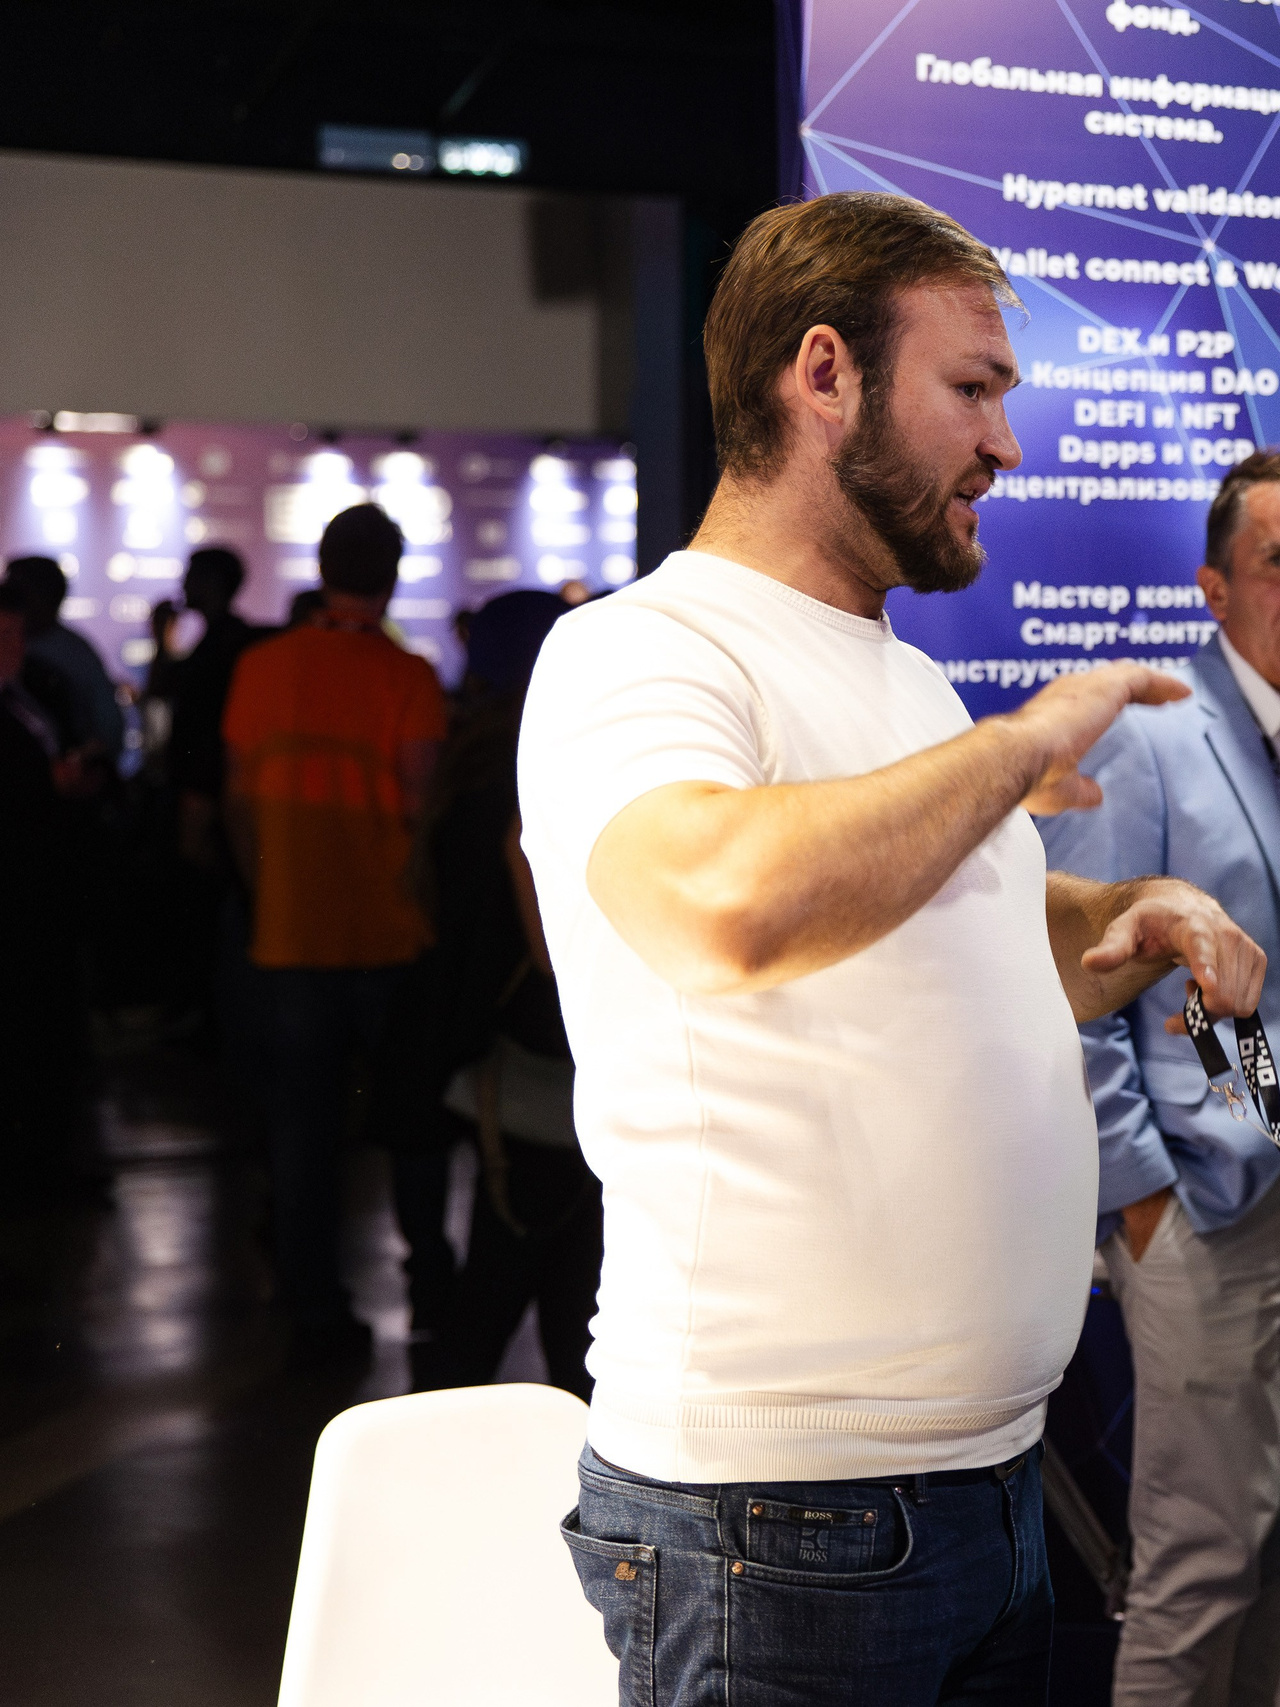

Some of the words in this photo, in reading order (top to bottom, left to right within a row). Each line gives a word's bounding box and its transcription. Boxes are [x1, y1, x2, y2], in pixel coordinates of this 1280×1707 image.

[1106, 0, 1200, 36] фонд.
[915, 52, 1103, 97] Глобальная
[1083, 109, 1223, 144] система.
[1002, 172, 1148, 211] Hypernet
[1084, 256, 1210, 287] connect
[1215, 259, 1238, 288] &
[1077, 325, 1142, 355] DEX
[1148, 333, 1170, 356] и
[1176, 329, 1235, 359] P2P
[1031, 361, 1206, 394] Концепция
[1211, 366, 1279, 397] DAO
[1074, 398, 1145, 428] DEFI
[1152, 405, 1174, 429] и
[1181, 402, 1241, 431] NFT
[1058, 434, 1156, 470] Dapps
[1162, 442, 1184, 465] и
[1012, 580, 1130, 614] Мастер
[804, 1510, 832, 1520] BOSS
[799, 1549, 828, 1562] BOSS
